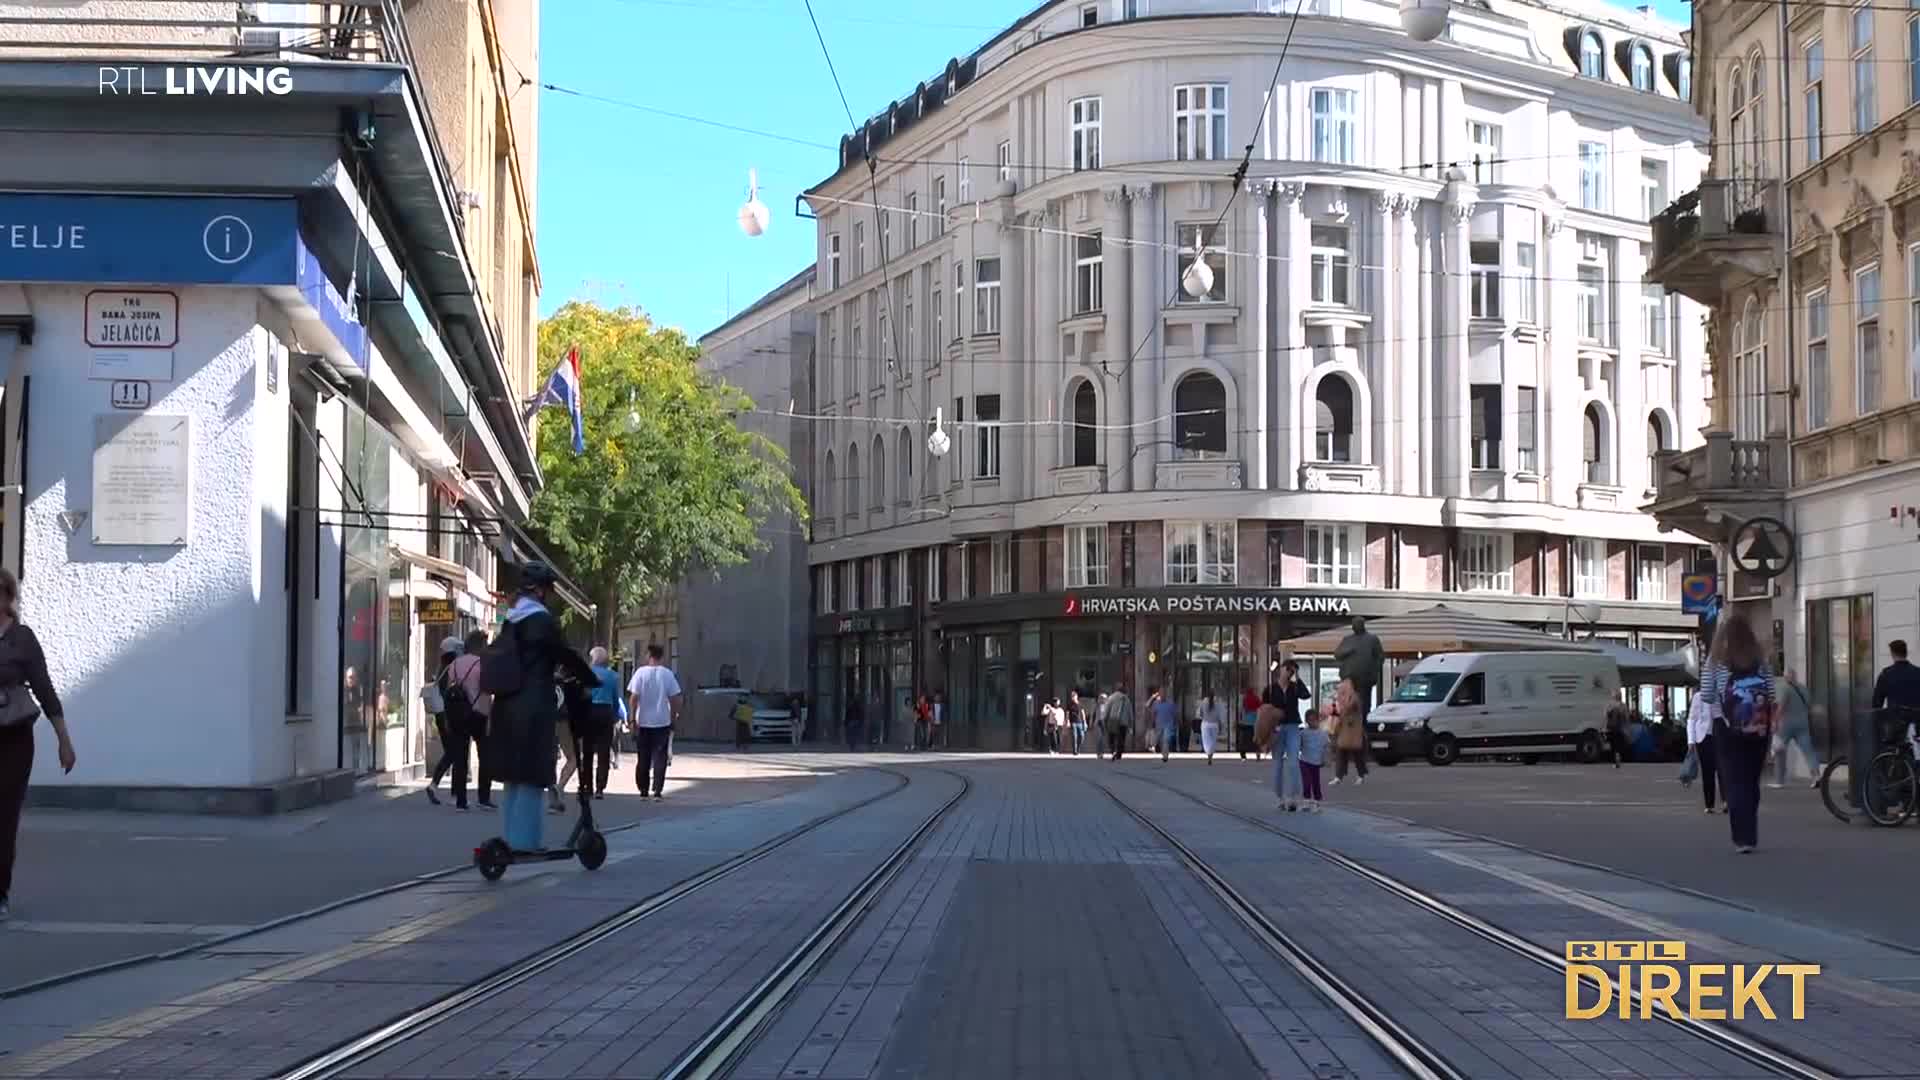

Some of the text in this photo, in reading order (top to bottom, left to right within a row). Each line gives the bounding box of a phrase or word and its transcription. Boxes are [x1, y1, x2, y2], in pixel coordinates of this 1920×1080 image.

[0, 225, 85, 248] ELJE
[130, 311, 161, 320] JOSIPA
[101, 323, 161, 342] JELAČIĆA
[123, 383, 138, 400] 11
[1081, 595, 1351, 612] HRVATSKA POŠTANSKA BANKA
